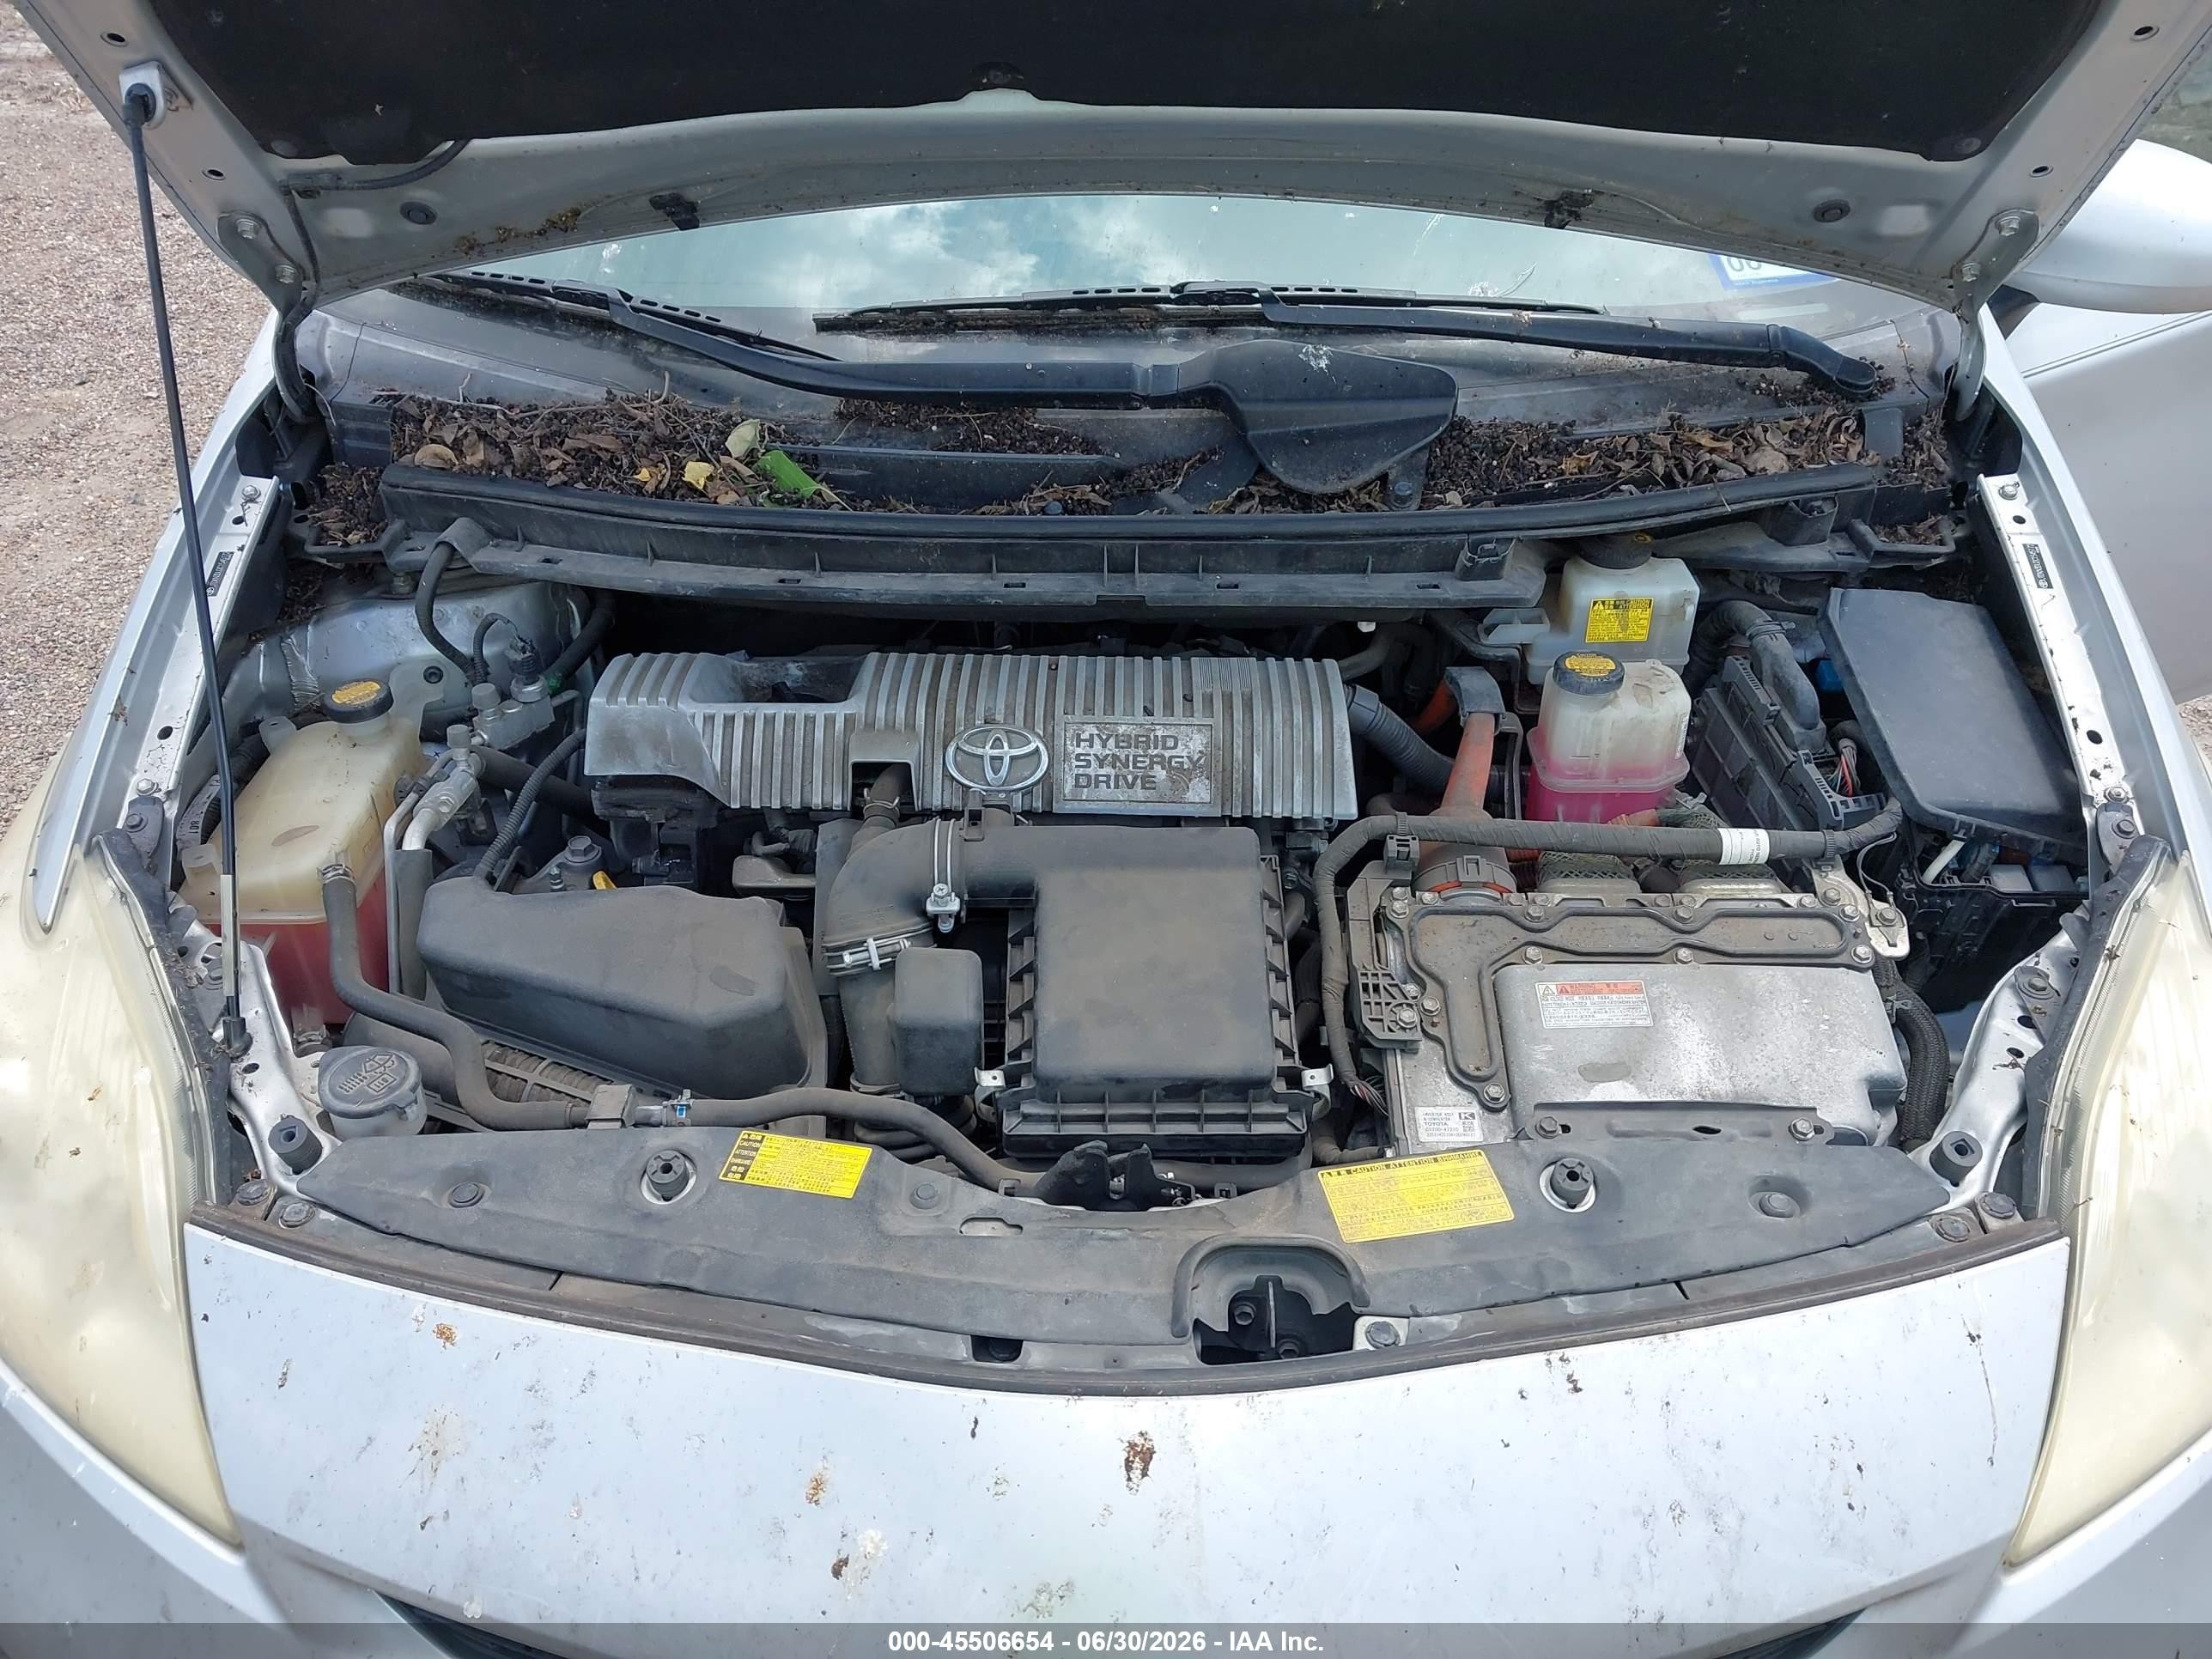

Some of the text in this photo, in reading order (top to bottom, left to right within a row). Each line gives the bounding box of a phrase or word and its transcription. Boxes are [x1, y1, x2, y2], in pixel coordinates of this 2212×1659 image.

[1075, 732, 1179, 750] HYBRID
[1074, 752, 1206, 770] SYNERGY
[1074, 773, 1158, 790] DRIVE
[1351, 1164, 1386, 1175] CAUTION
[1389, 1157, 1435, 1170] ATTENTION
